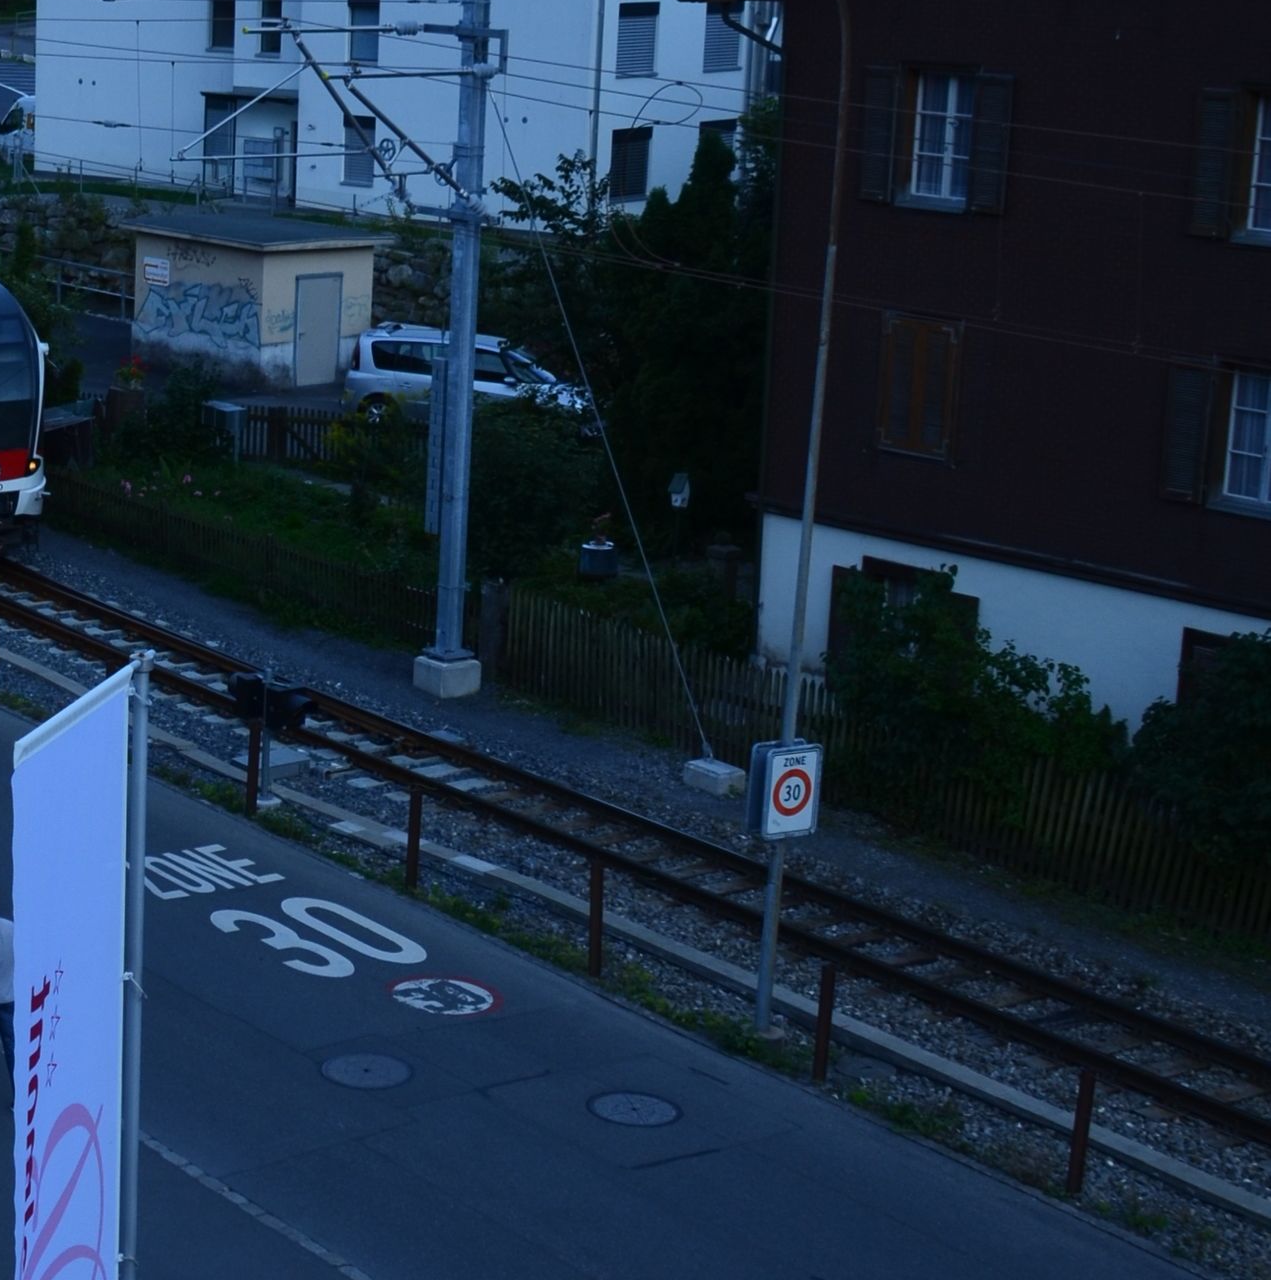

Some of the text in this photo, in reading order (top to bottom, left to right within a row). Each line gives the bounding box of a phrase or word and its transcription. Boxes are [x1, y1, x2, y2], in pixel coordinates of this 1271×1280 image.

[783, 755, 808, 768] ZONE
[783, 783, 801, 802] 30
[209, 896, 428, 978] 30
